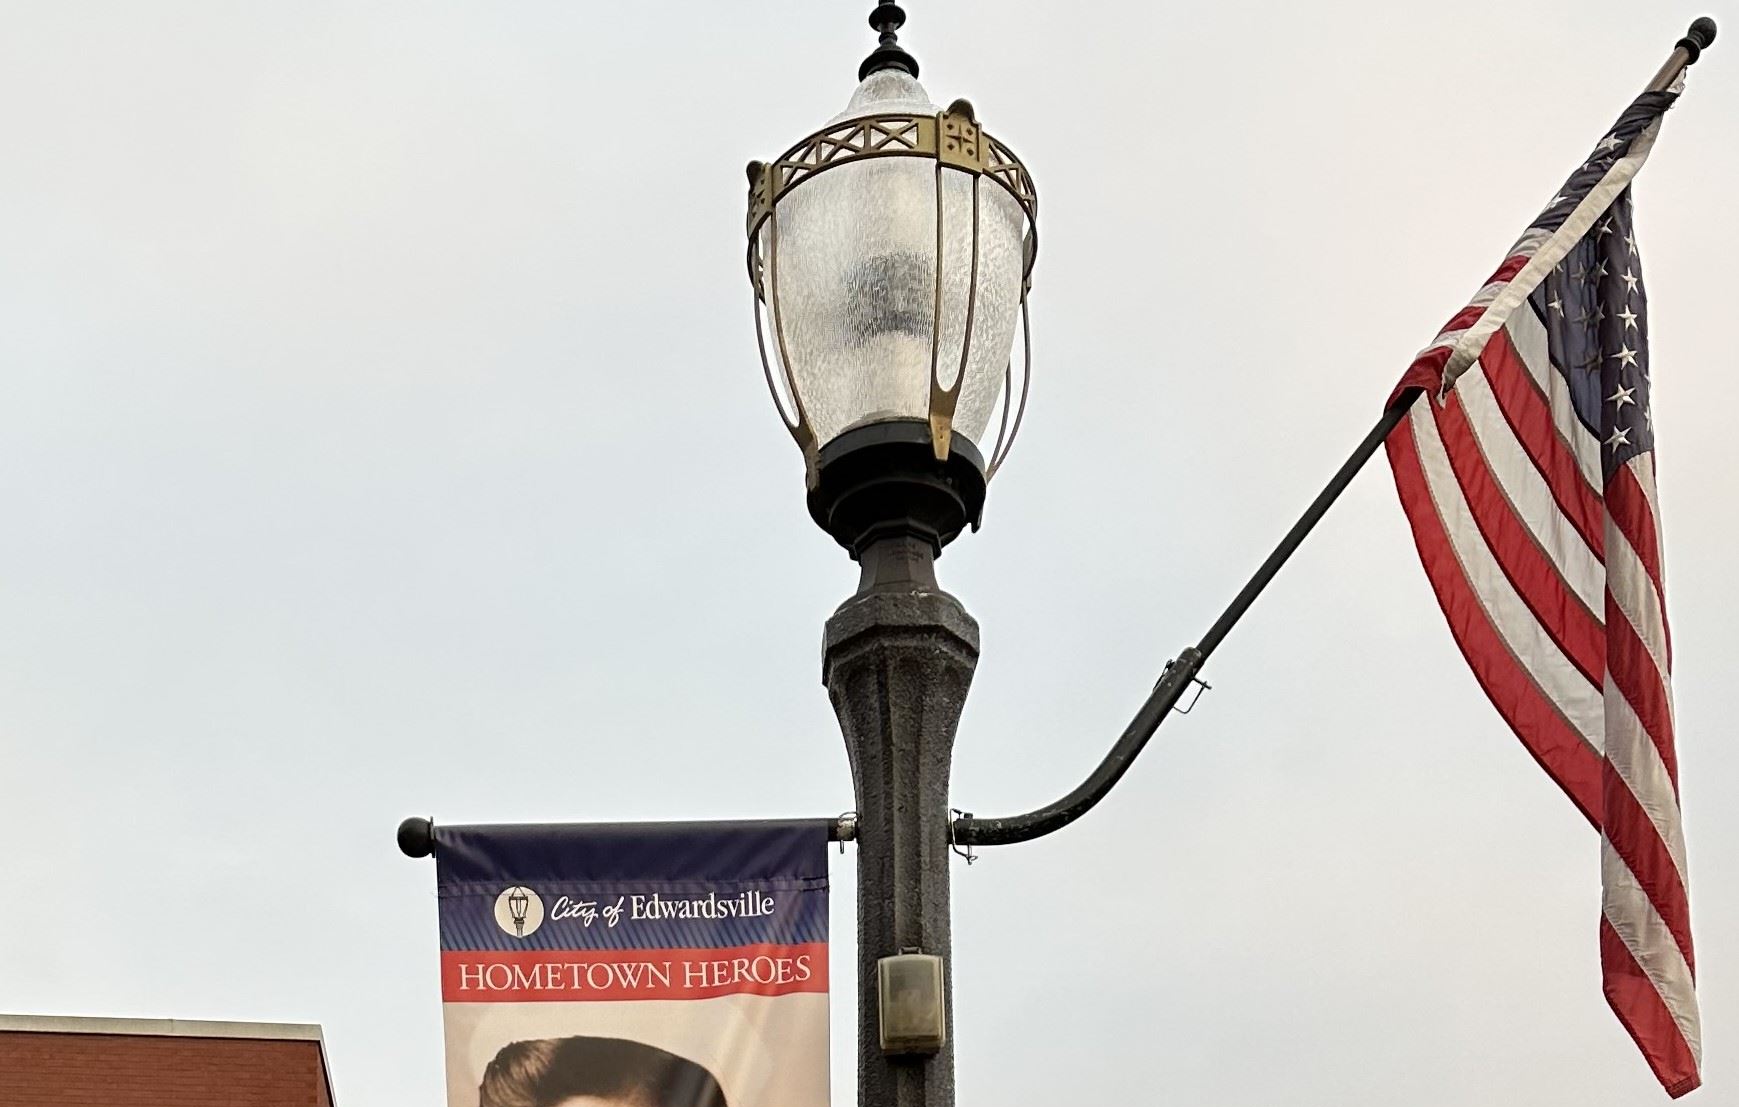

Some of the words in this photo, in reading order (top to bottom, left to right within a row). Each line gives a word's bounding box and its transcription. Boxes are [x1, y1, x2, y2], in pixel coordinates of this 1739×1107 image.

[551, 896, 598, 927] City
[602, 897, 624, 927] of
[630, 890, 775, 920] Edwardsville
[459, 962, 670, 991] HOMETOWN
[682, 955, 811, 987] HEROES
